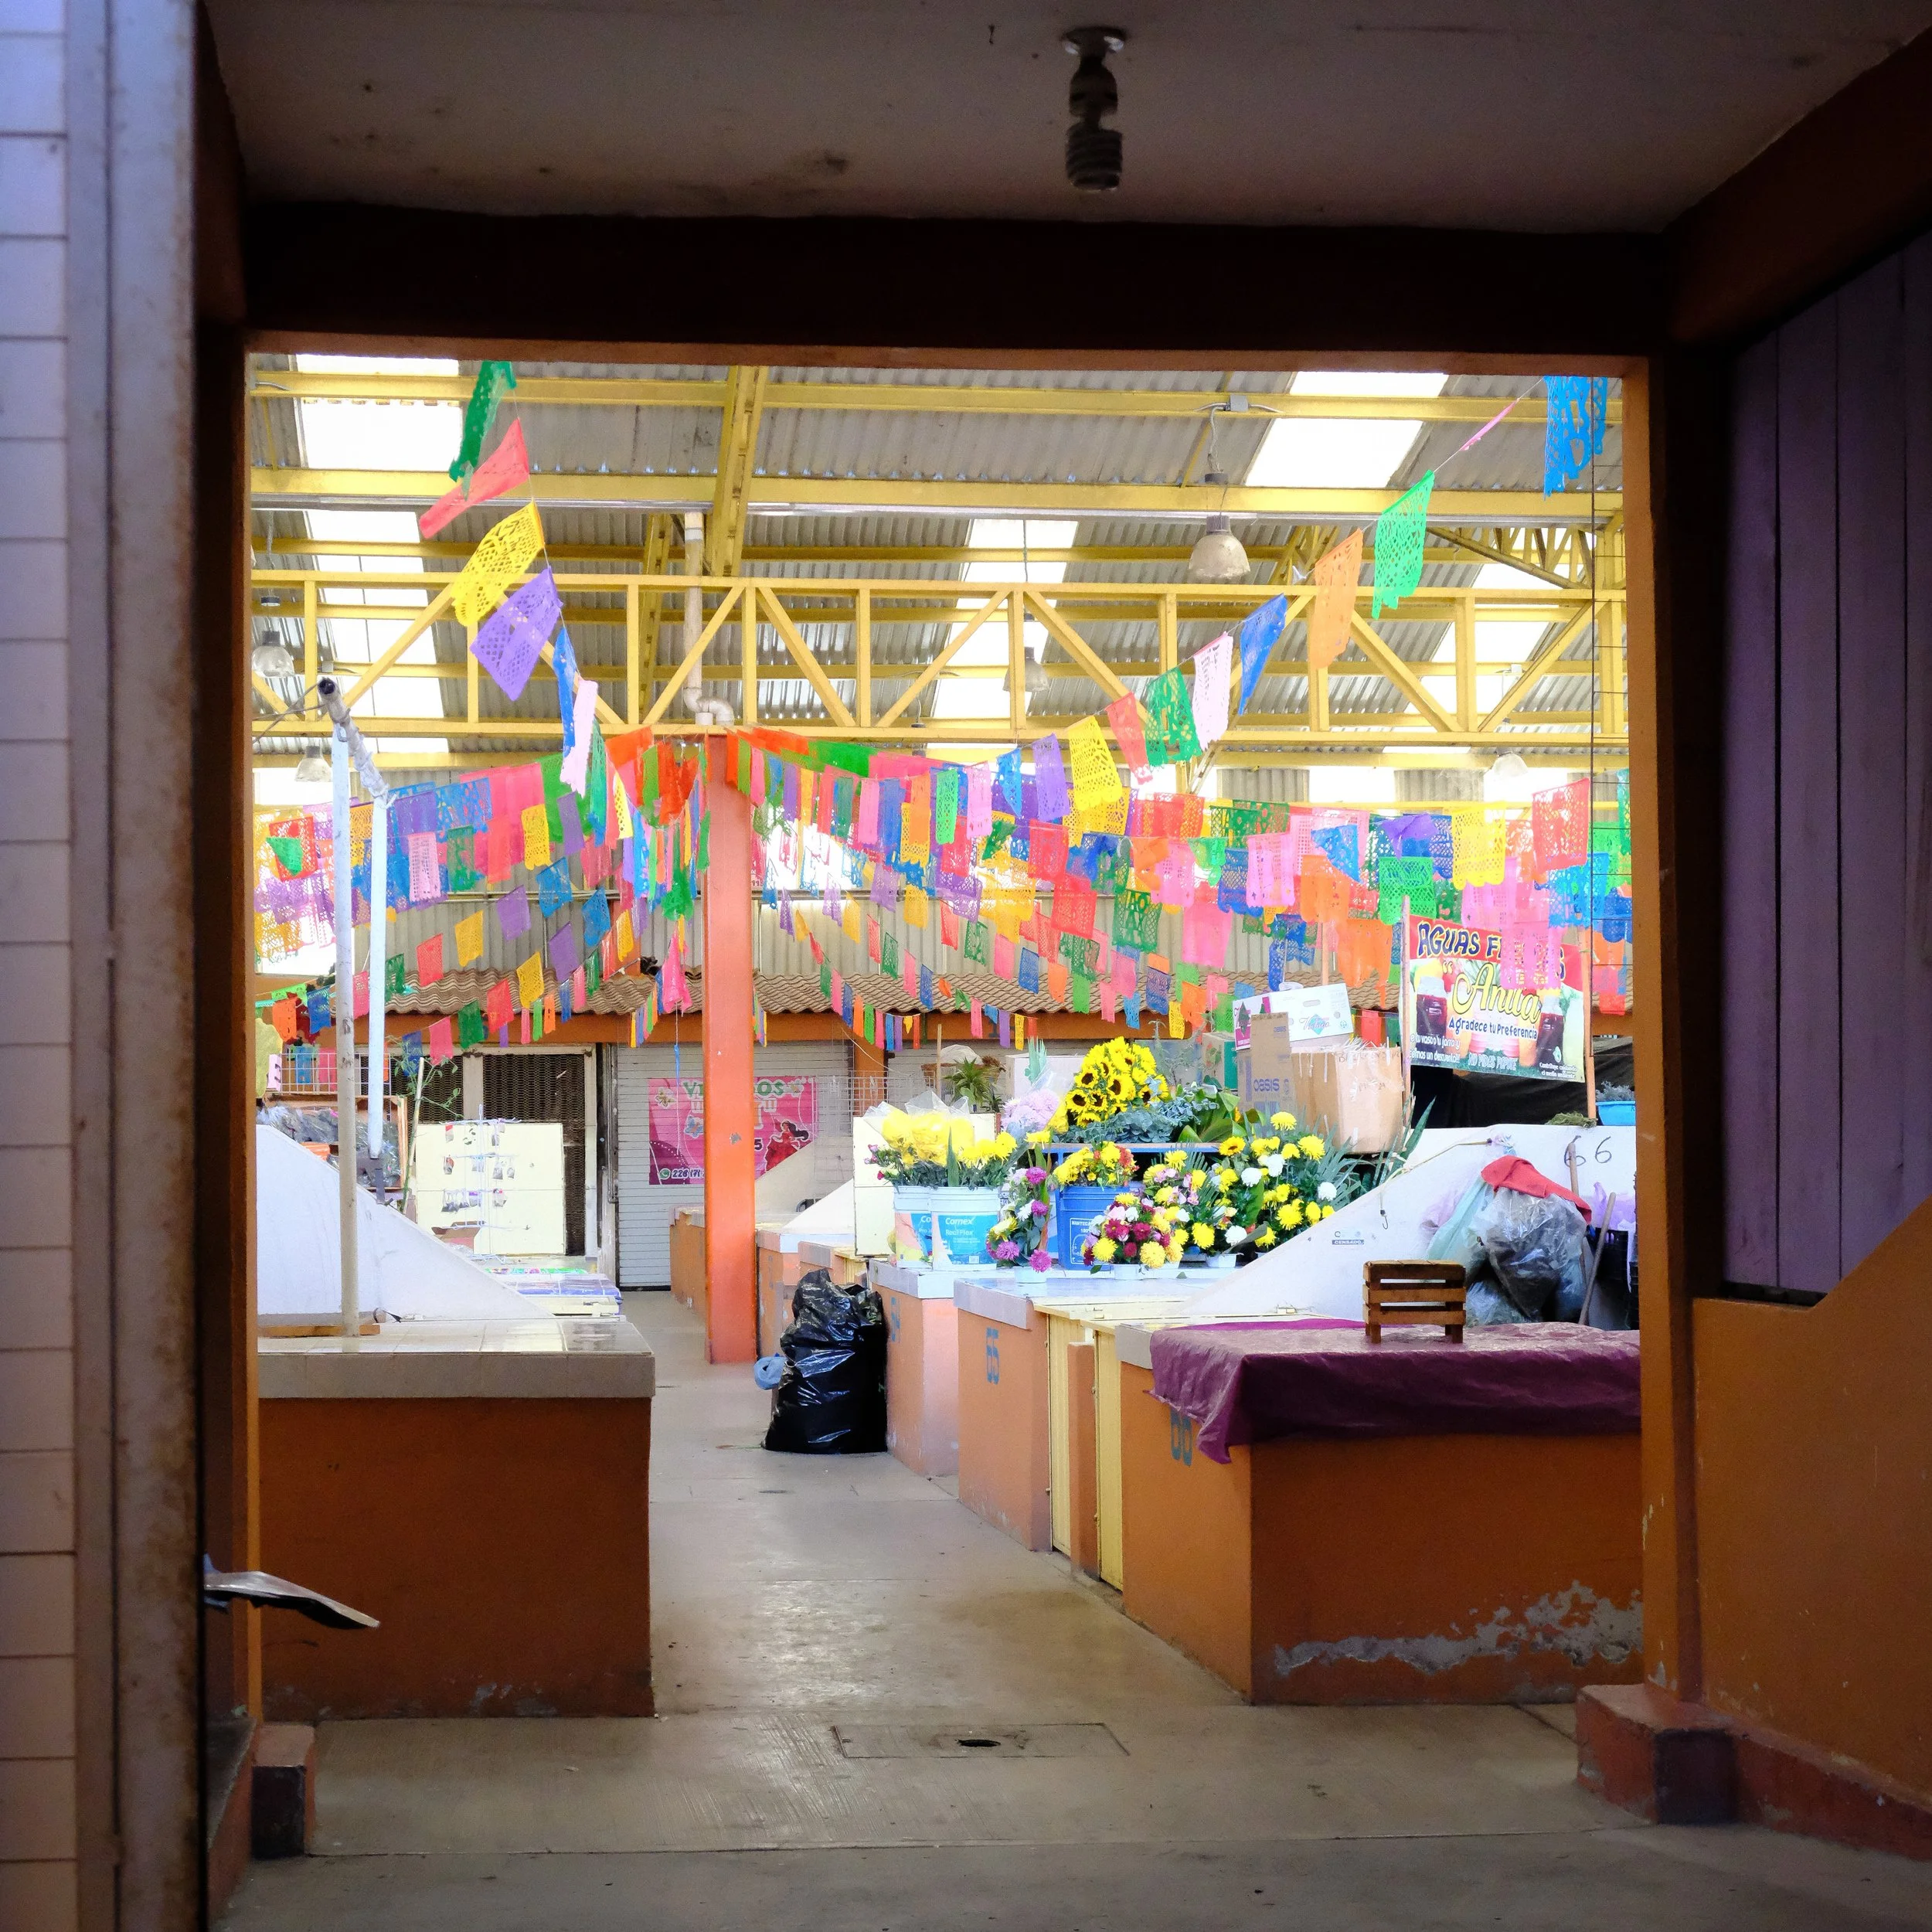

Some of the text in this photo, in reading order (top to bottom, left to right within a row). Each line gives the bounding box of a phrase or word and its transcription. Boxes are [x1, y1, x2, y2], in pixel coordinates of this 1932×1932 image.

[1417, 923, 1480, 957] AGUAS
[1449, 1017, 1537, 1039] Agradece tu Preferencia
